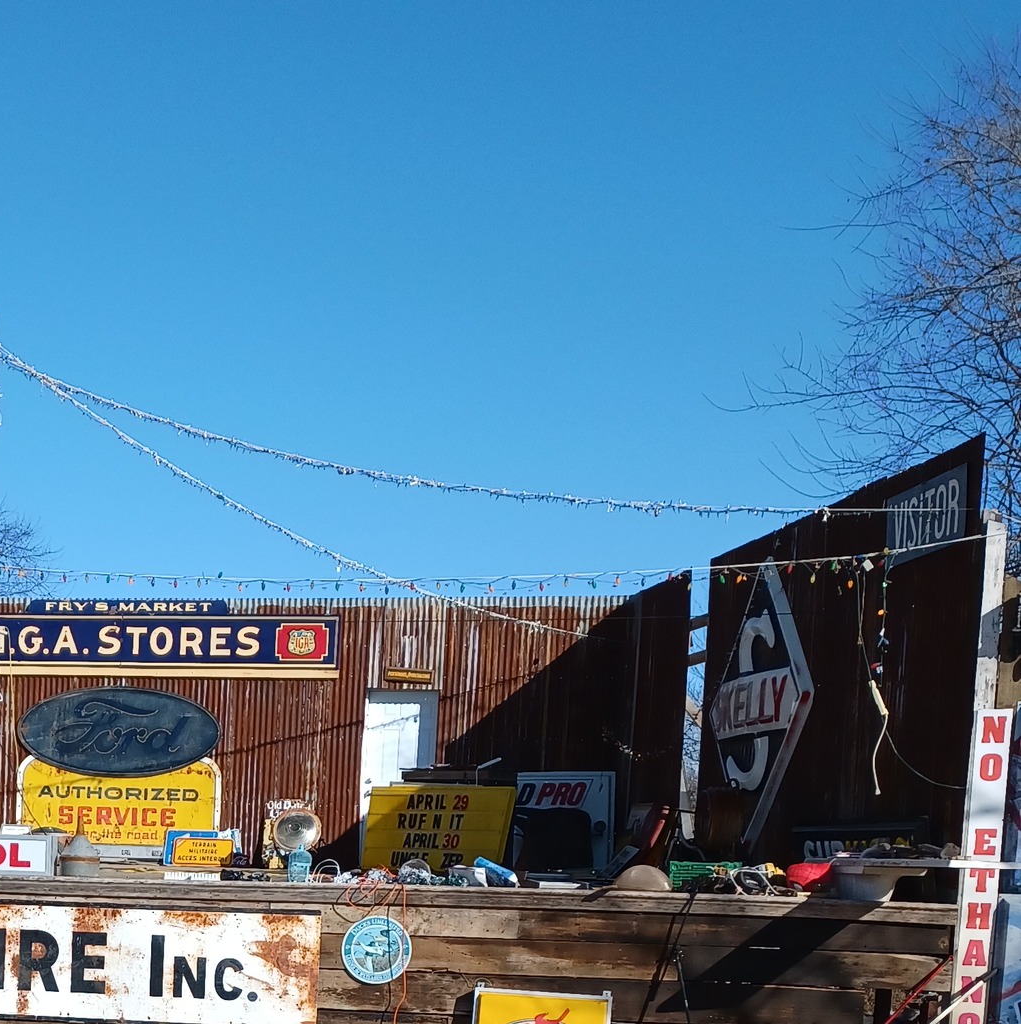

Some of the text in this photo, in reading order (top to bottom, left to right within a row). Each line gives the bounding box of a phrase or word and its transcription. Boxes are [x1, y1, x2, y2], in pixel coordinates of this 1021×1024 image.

[893, 478, 960, 550] VISITOR
[45, 601, 212, 612] FRY'S MARKET
[97, 625, 261, 656] STORES
[52, 697, 192, 755] Ford
[980, 715, 1008, 782] NO
[38, 785, 199, 802] AUTHORIZED
[407, 794, 470, 811] APRIL 29
[535, 781, 588, 806] PRO
[58, 805, 177, 827] SERVICE
[397, 812, 465, 829] RUF N IT
[126, 829, 159, 840] road
[402, 832, 461, 849] APRIL 30
